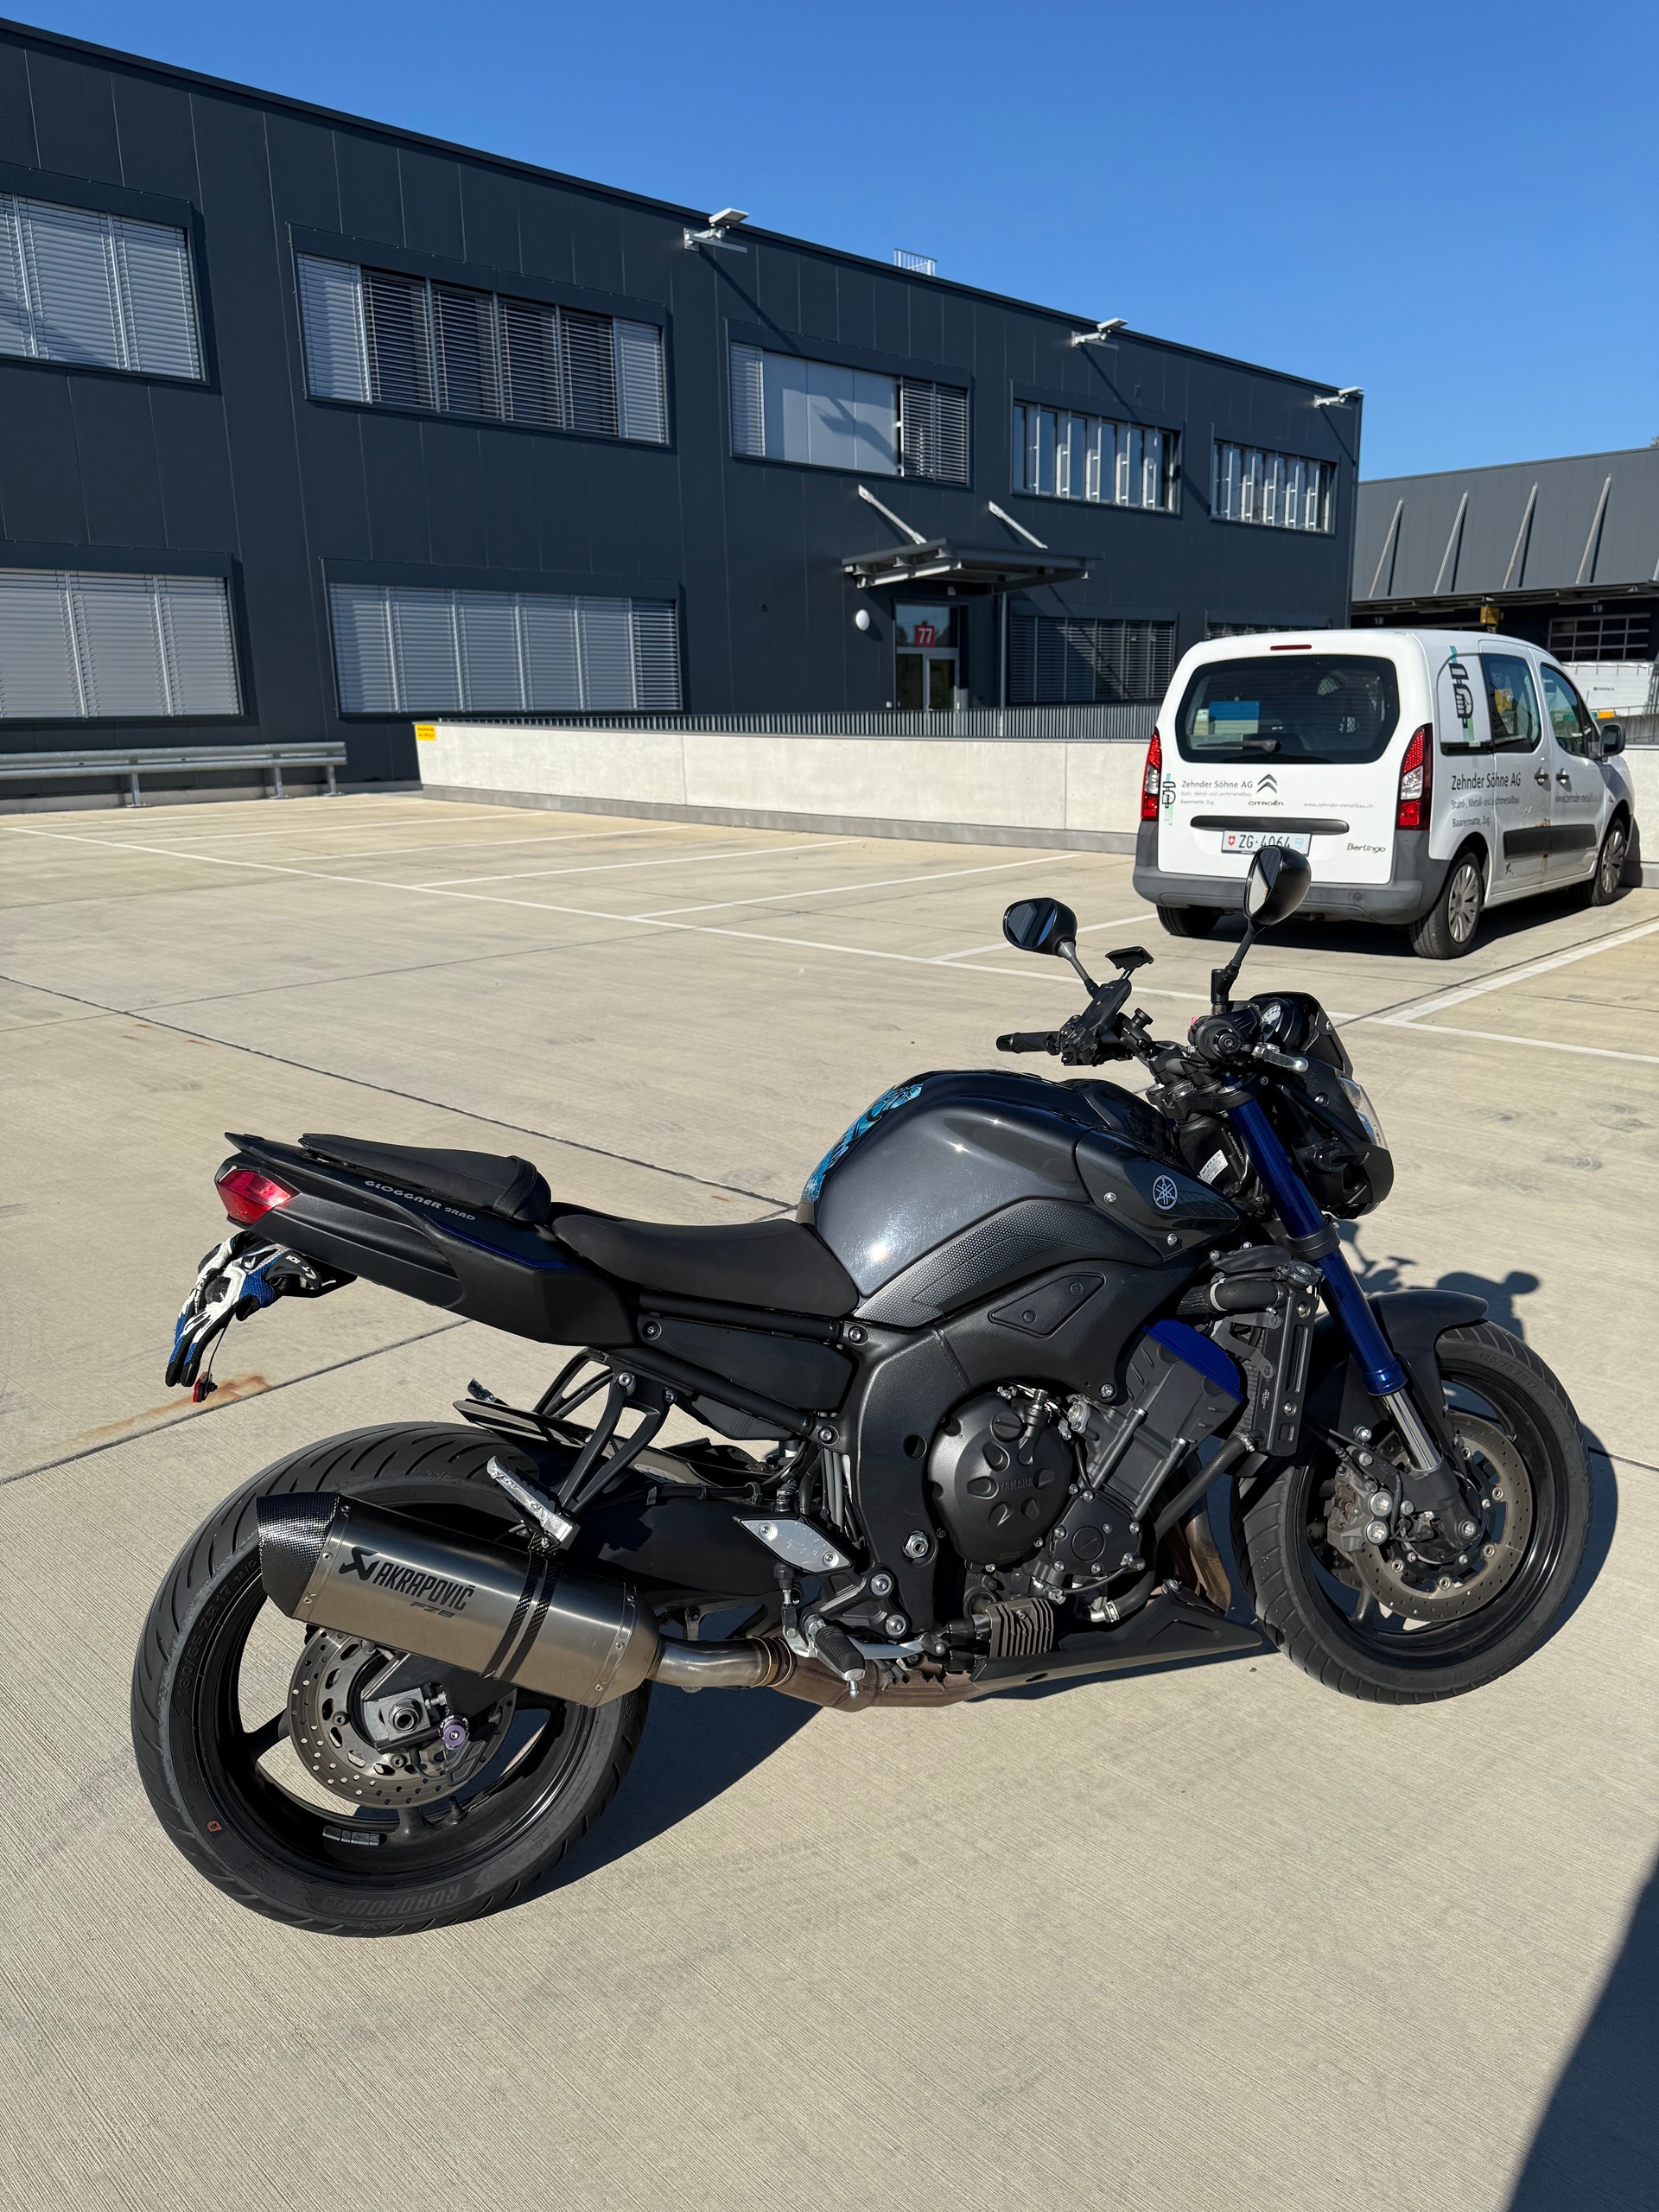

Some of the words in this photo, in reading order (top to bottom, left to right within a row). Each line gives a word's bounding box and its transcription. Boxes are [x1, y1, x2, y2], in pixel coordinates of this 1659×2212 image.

[1592, 604, 1603, 613] 19
[918, 627, 933, 644] 77
[1182, 779, 1212, 788] Zehnder
[1214, 779, 1238, 788] Söhne
[1452, 772, 1484, 791] Zehnder
[1486, 771, 1509, 788] Söhne
[1510, 772, 1521, 787] AG
[1347, 842, 1386, 854] Berlingo
[365, 1180, 442, 1209] GLOGGNER
[444, 1206, 476, 1221] 2RAD
[1478, 1352, 1514, 1372] 120/70
[999, 1478, 1033, 1491] YAMAHA
[410, 1601, 455, 1618] FZ8
